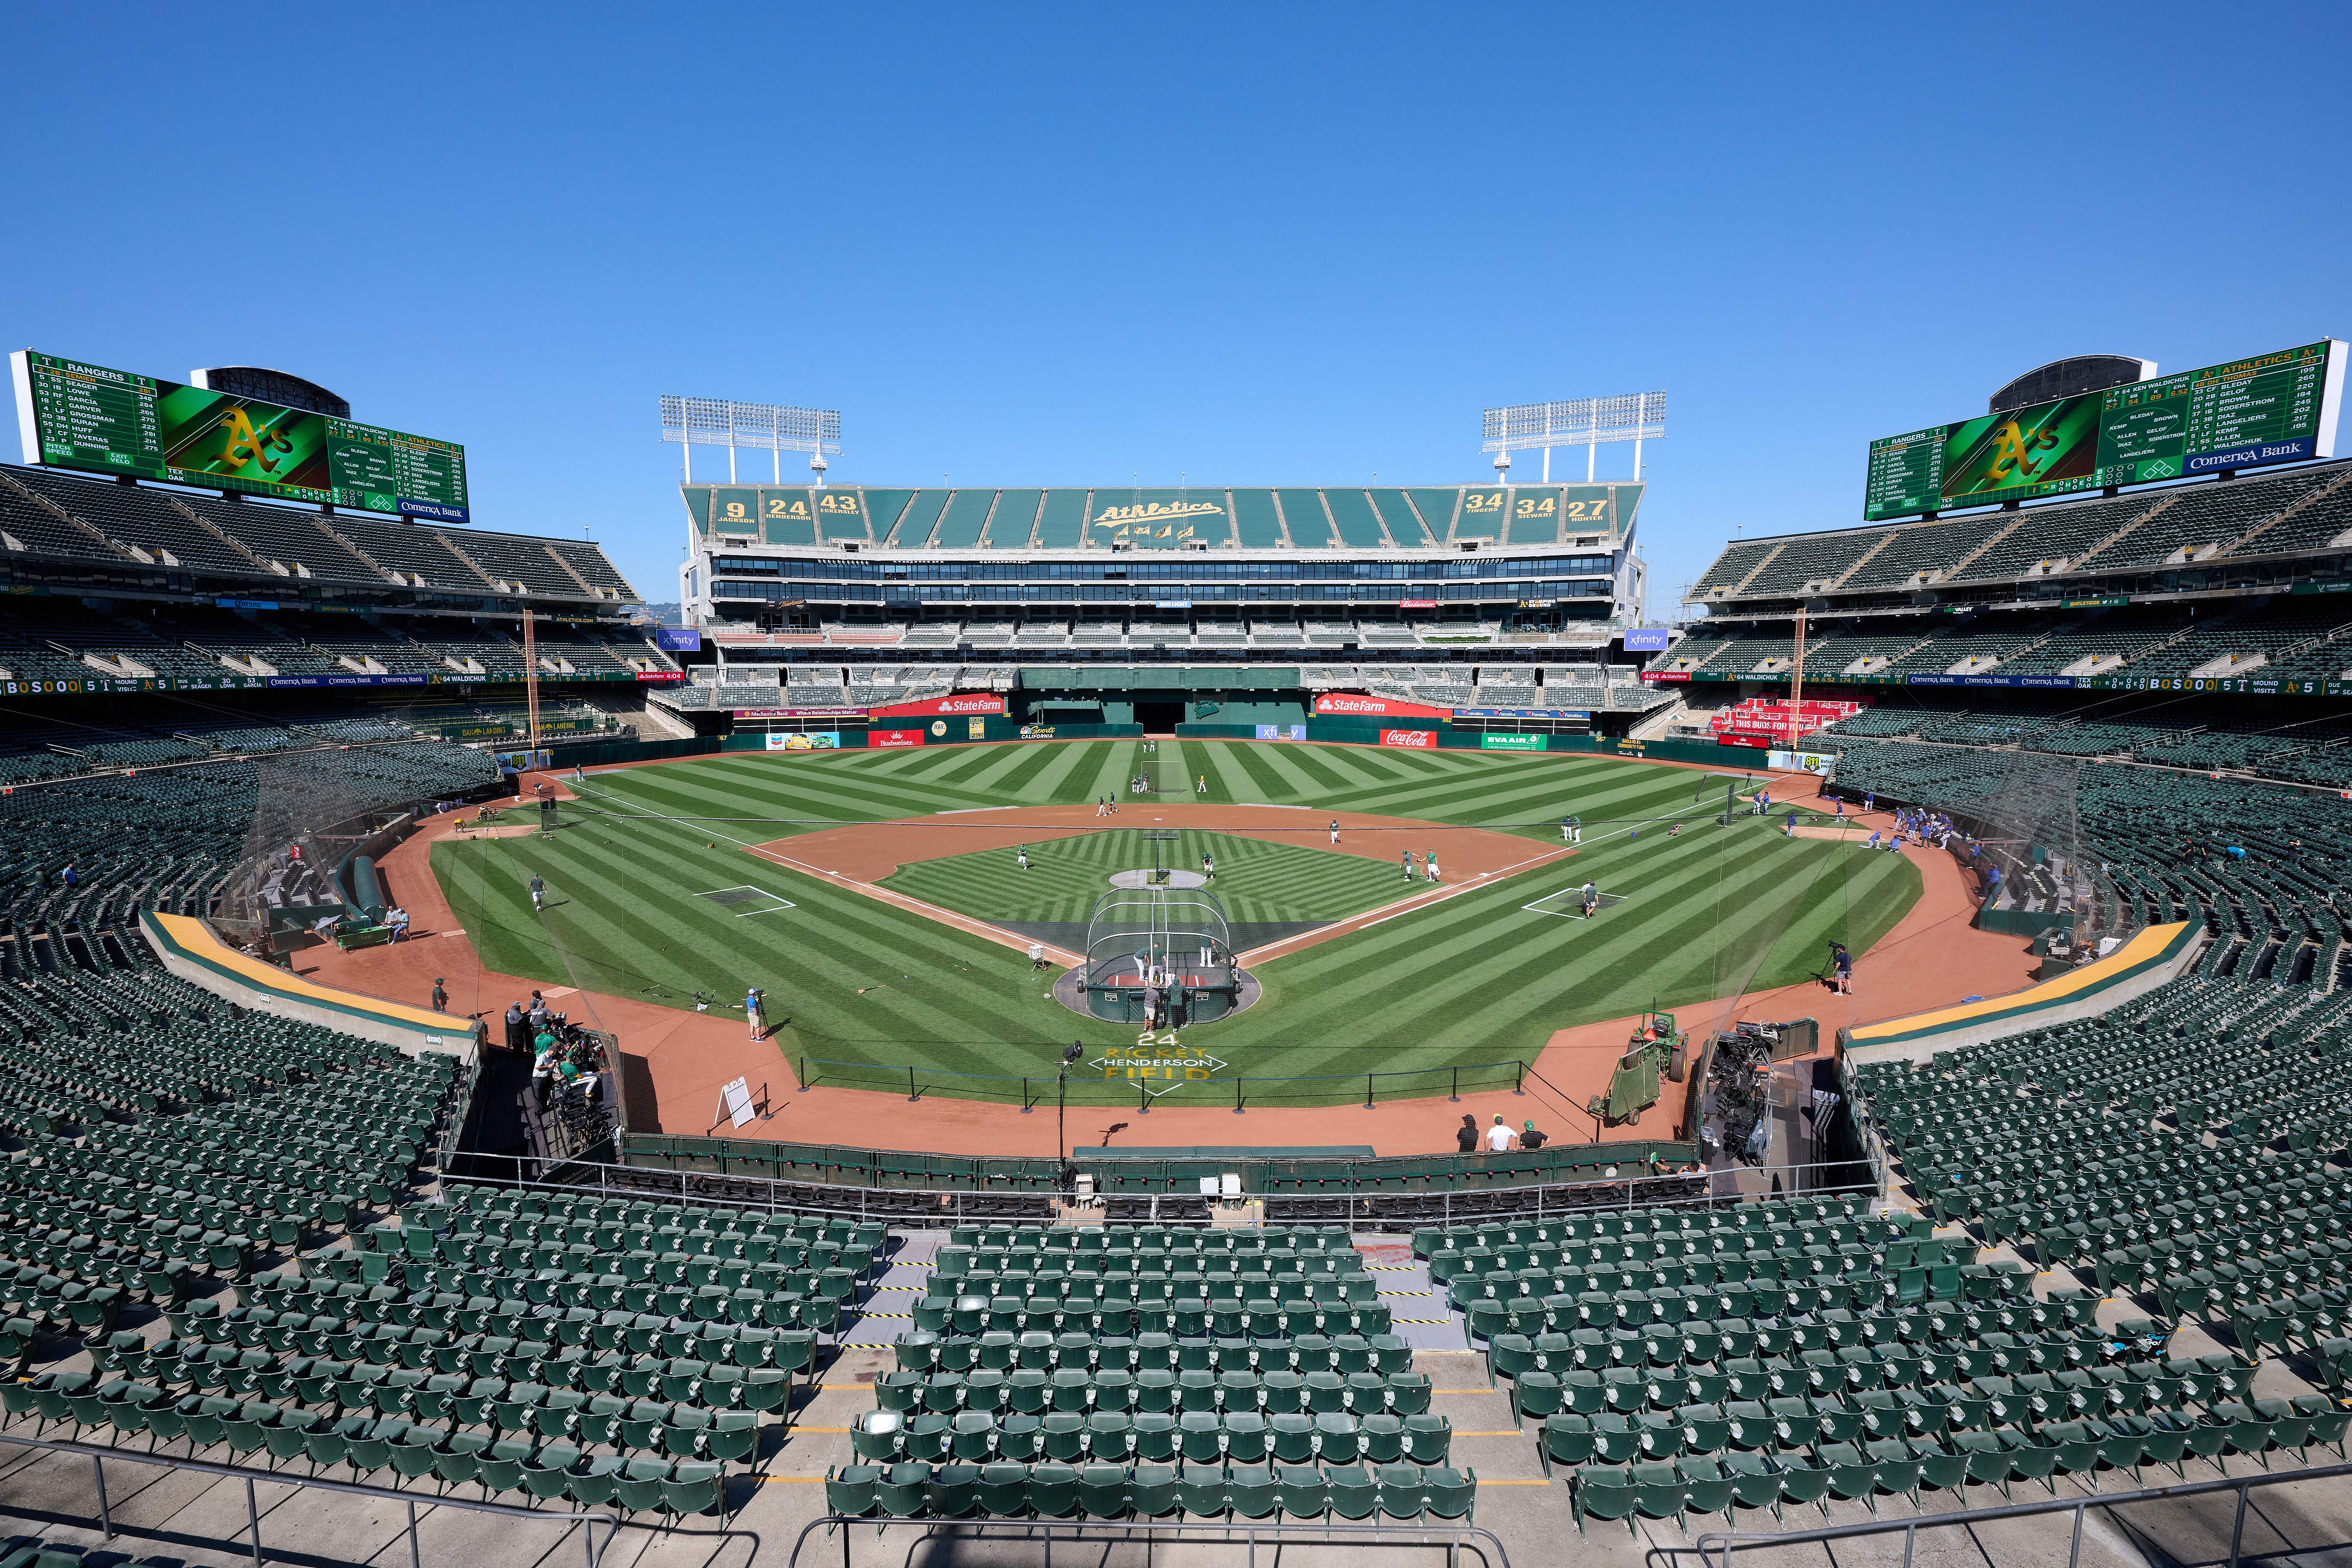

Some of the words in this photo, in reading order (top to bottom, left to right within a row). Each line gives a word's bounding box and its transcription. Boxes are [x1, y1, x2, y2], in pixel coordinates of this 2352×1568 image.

[2222, 354, 2291, 374] ATHLETICS
[65, 372, 97, 382] SEMIEN
[67, 364, 124, 381] RANGERS
[2222, 371, 2258, 381] THOMAS
[66, 381, 97, 390] SEAGER
[2148, 376, 2189, 388] WALDICHUK
[2222, 379, 2252, 389] BLEDAY
[67, 388, 90, 396] LOWE
[2220, 388, 2246, 396] GELOF
[2219, 395, 2249, 405] BROWN
[2219, 397, 2275, 412] SODERSTROM
[69, 403, 101, 413] GARVER
[70, 411, 114, 422] GROSSMAN
[2217, 414, 2266, 427] LANGELIERS
[71, 418, 98, 427] DURAN
[359, 426, 387, 435] WALDICHUK
[73, 433, 108, 443] TAVERAS
[406, 437, 446, 449] ATHLETICS
[1891, 433, 1927, 446] RANGERS
[2214, 434, 2240, 442] ALLEN
[2214, 437, 2262, 449] WALDICHUK
[74, 441, 109, 450] DUNNING
[408, 443, 430, 451] THOMAS
[2261, 443, 2302, 457] Bank
[411, 467, 442, 475] SODERSTROM
[821, 495, 858, 511] 43
[1466, 493, 1503, 510] 34
[1517, 498, 1556, 515] 34
[442, 508, 462, 517] Bank
[727, 503, 745, 517] 9
[770, 500, 807, 516] 24
[1568, 500, 1609, 518] 27
[1093, 501, 1222, 528] Athletics
[235, 599, 261, 609] Corona
[778, 599, 804, 609] Treehouse
[664, 635, 694, 646] xfinity
[1630, 635, 1662, 645] xfinity
[954, 700, 1001, 711] StateFarm
[1334, 700, 1385, 712] StateFarm
[553, 721, 575, 729] LANDING
[1736, 719, 1750, 728] THIS
[1752, 720, 1770, 729] BUDS
[1773, 721, 1786, 730] FOR
[1031, 725, 1055, 735] Sports
[1387, 730, 1429, 746] Coca-Cola
[512, 755, 525, 765] 811
[1805, 756, 1819, 766] 811
[1138, 1034, 1177, 1046] 24
[1106, 1048, 1206, 1058] RICKEY
[1105, 1068, 1211, 1080] FIELD
